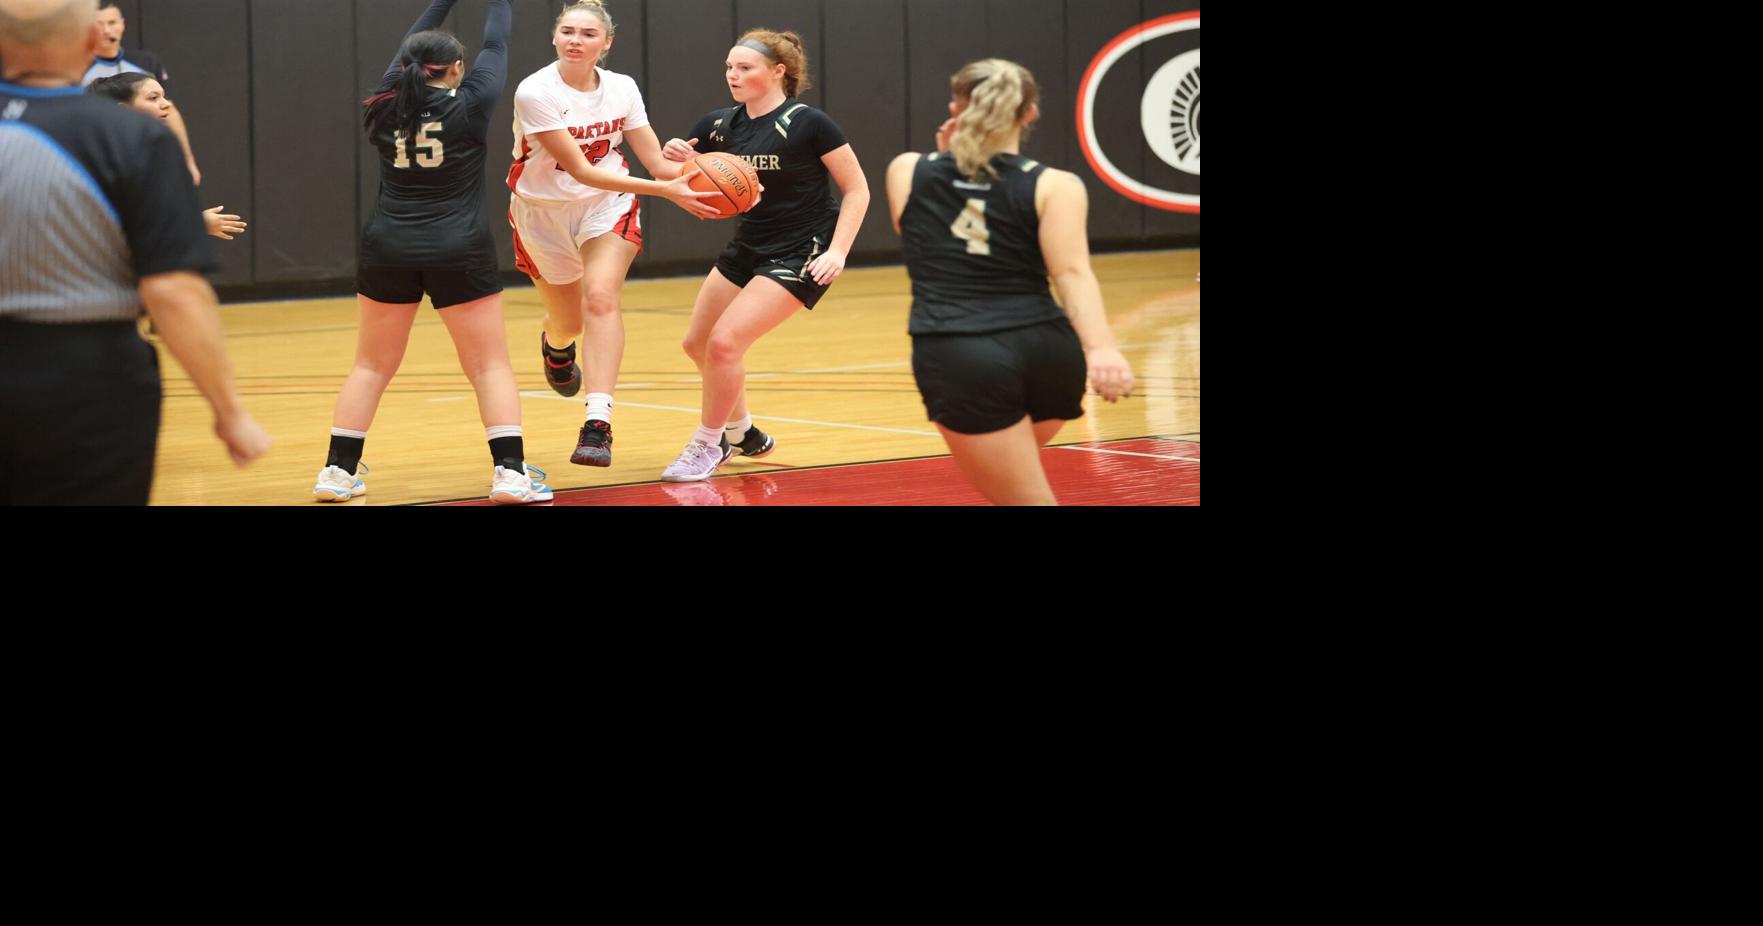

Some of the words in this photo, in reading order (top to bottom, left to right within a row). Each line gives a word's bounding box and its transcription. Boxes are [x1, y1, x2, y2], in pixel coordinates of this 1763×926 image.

[393, 122, 444, 168] 15
[567, 117, 626, 139] PARTANS
[950, 198, 991, 255] 4
